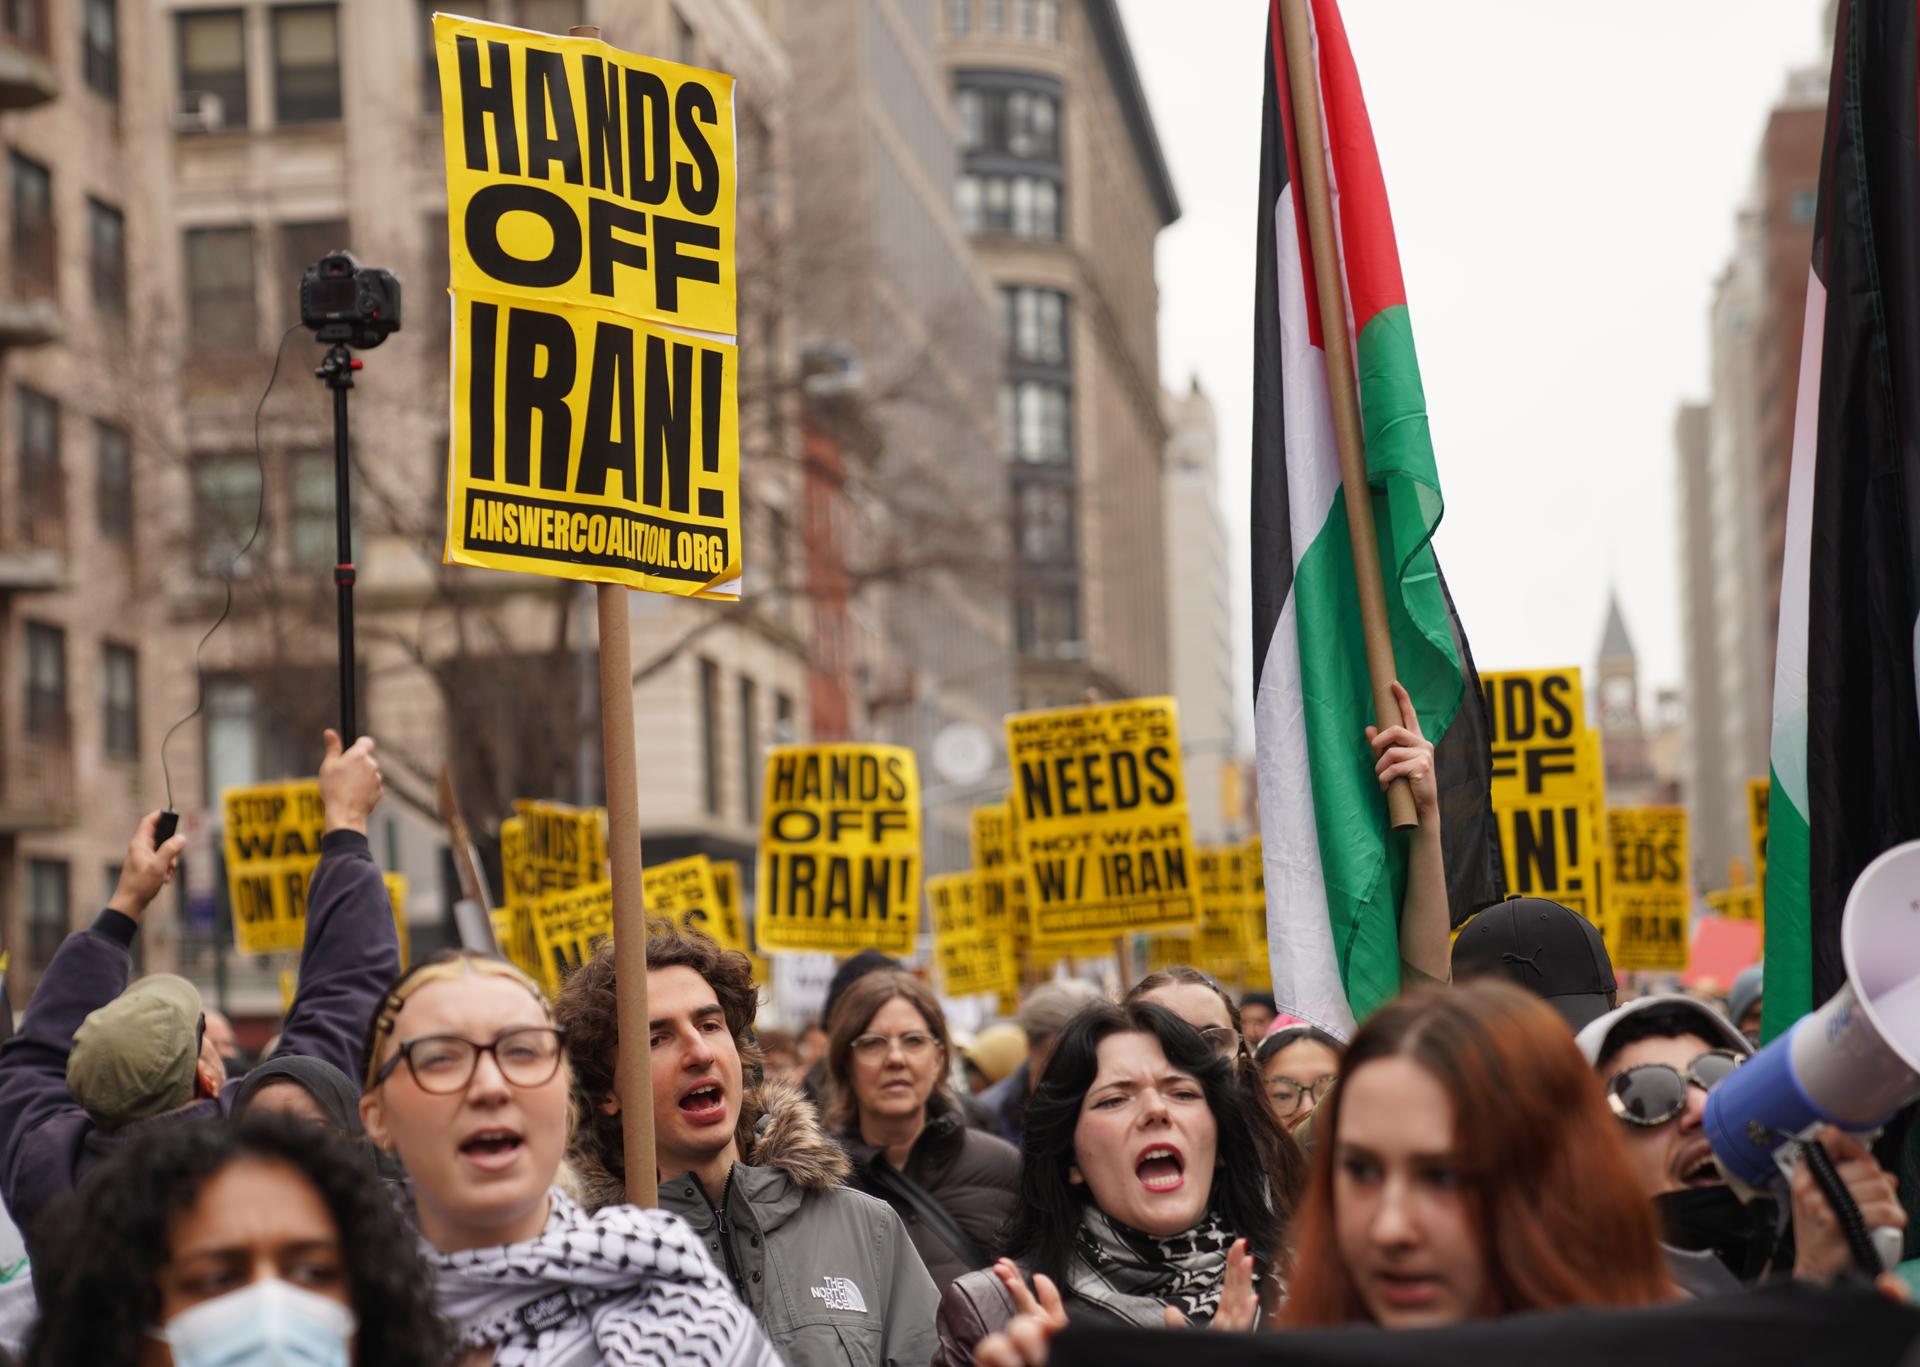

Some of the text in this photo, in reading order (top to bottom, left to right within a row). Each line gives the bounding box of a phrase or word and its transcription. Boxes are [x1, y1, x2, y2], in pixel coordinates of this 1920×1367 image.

[455, 34, 719, 216] HANDS
[464, 183, 720, 313] OFF
[469, 300, 724, 519] IRAN!
[470, 498, 723, 574] ANSWERCOALITION.ORG
[1013, 707, 1167, 734] MONEY FOR
[773, 755, 906, 803] HANDS
[1021, 746, 1175, 821] NEEDS
[230, 795, 286, 827] STOP
[771, 810, 907, 843] OFF
[1030, 832, 1093, 853] NOT
[1101, 824, 1181, 846] WAR
[1101, 847, 1188, 897] IRAN
[1614, 840, 1681, 883] EDS
[769, 854, 909, 922] IRAN!
[810, 1286, 848, 1300] NORTH
[824, 1276, 846, 1289] THE
[825, 1298, 851, 1311] FACE
